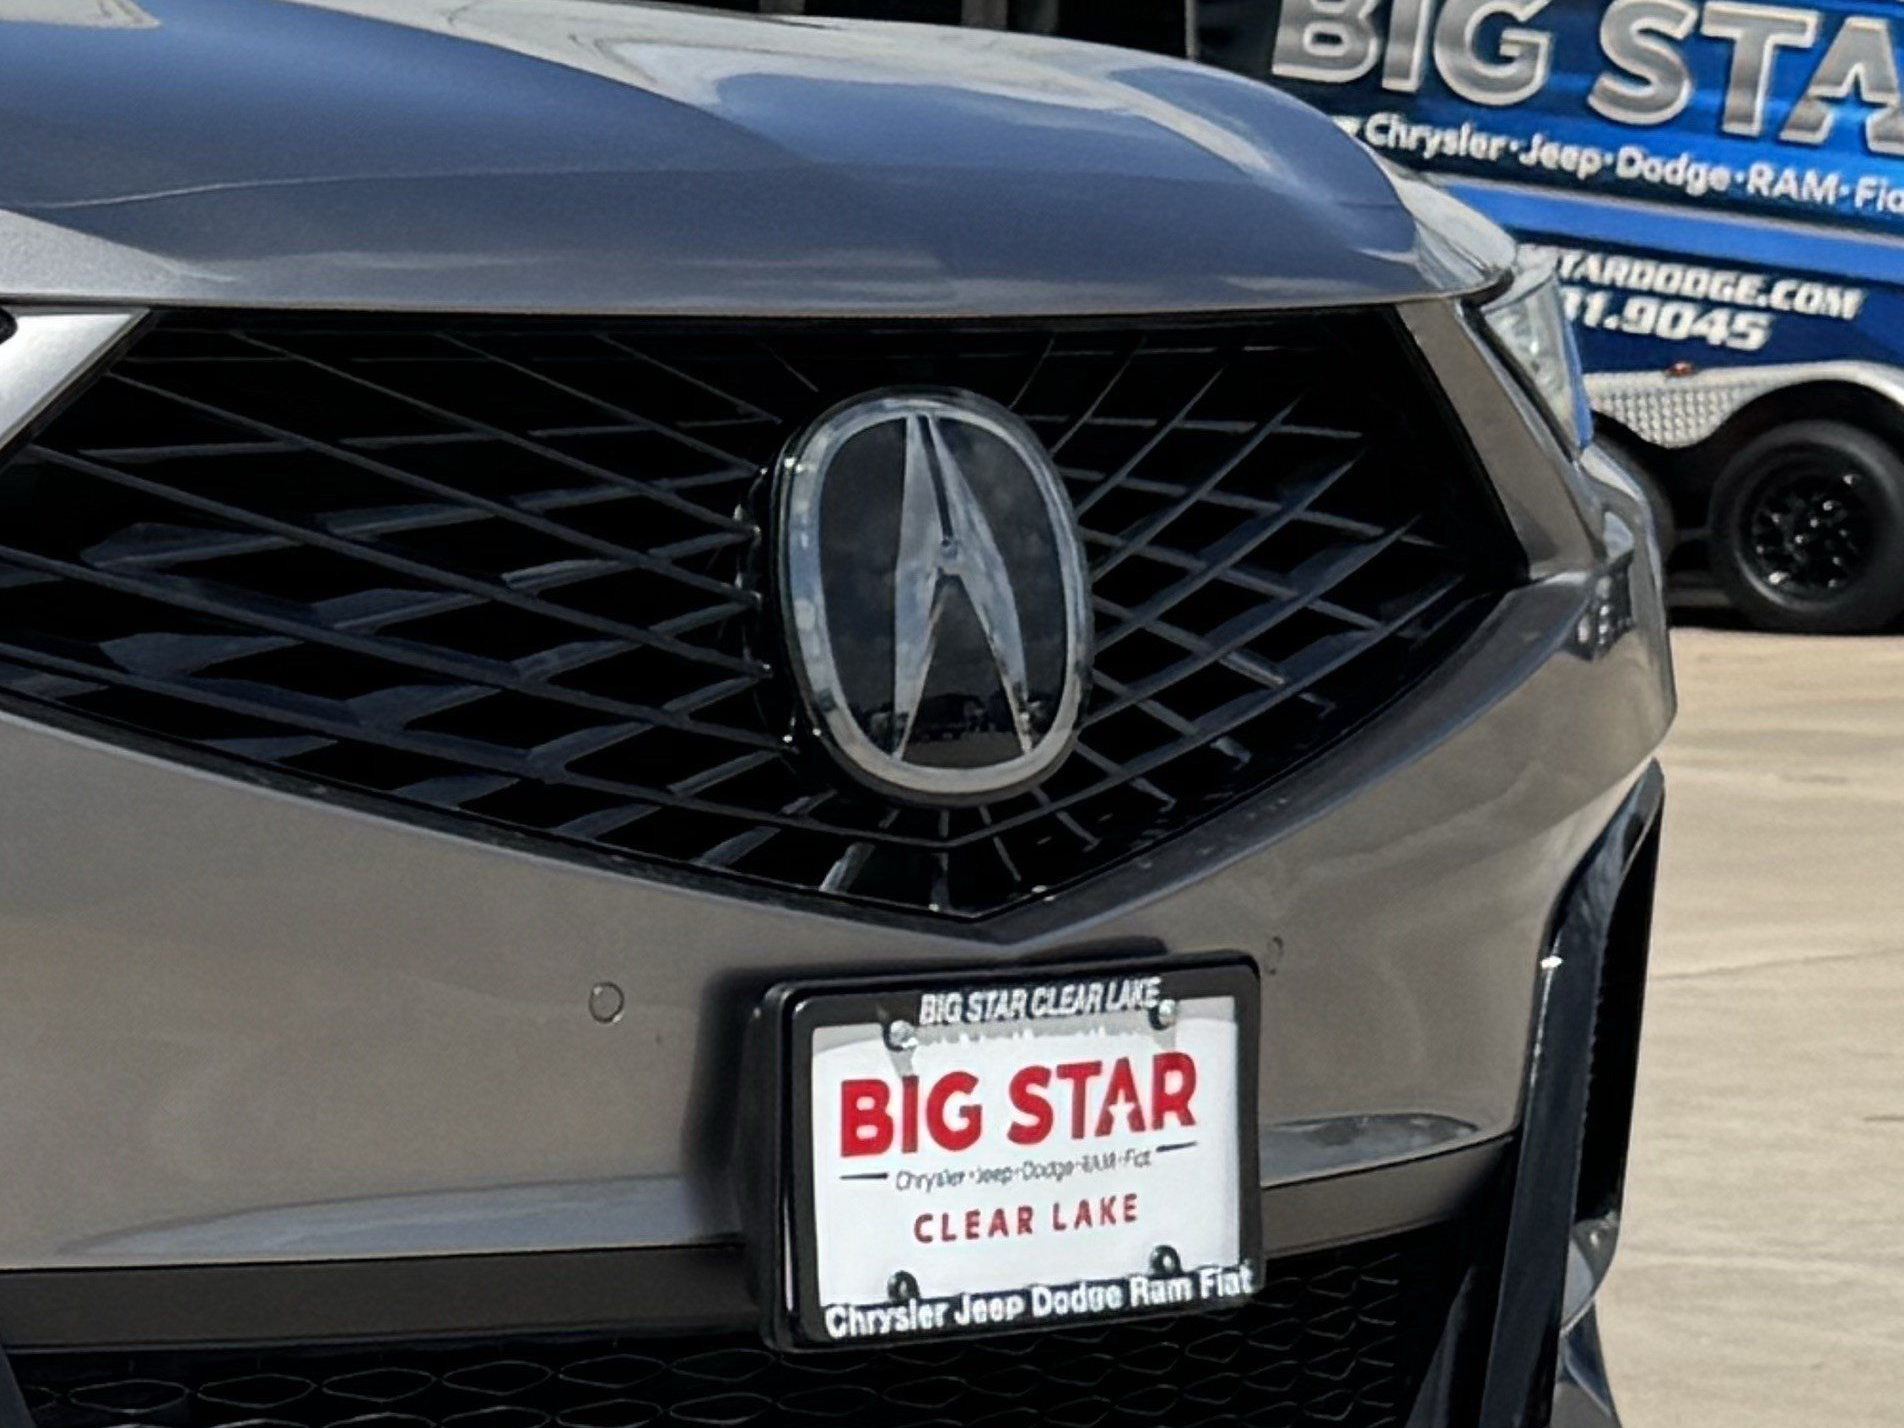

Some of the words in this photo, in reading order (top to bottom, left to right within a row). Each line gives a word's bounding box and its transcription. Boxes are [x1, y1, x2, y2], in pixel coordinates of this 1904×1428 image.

[919, 992, 963, 1025] BIG
[968, 988, 1028, 1022] STAR
[1031, 982, 1104, 1016] CLEAR
[1104, 976, 1162, 1010] LAKE
[840, 1071, 983, 1157] BIG
[1006, 1051, 1197, 1145] STAR
[913, 1205, 1034, 1243] CLEAR
[1052, 1193, 1138, 1231] LAKE
[824, 1300, 948, 1339] Chrysler
[954, 1292, 1025, 1326] Jeep
[1031, 1282, 1123, 1317] Dodge
[1130, 1275, 1190, 1307] Ram
[1199, 1262, 1254, 1300] Fiat
